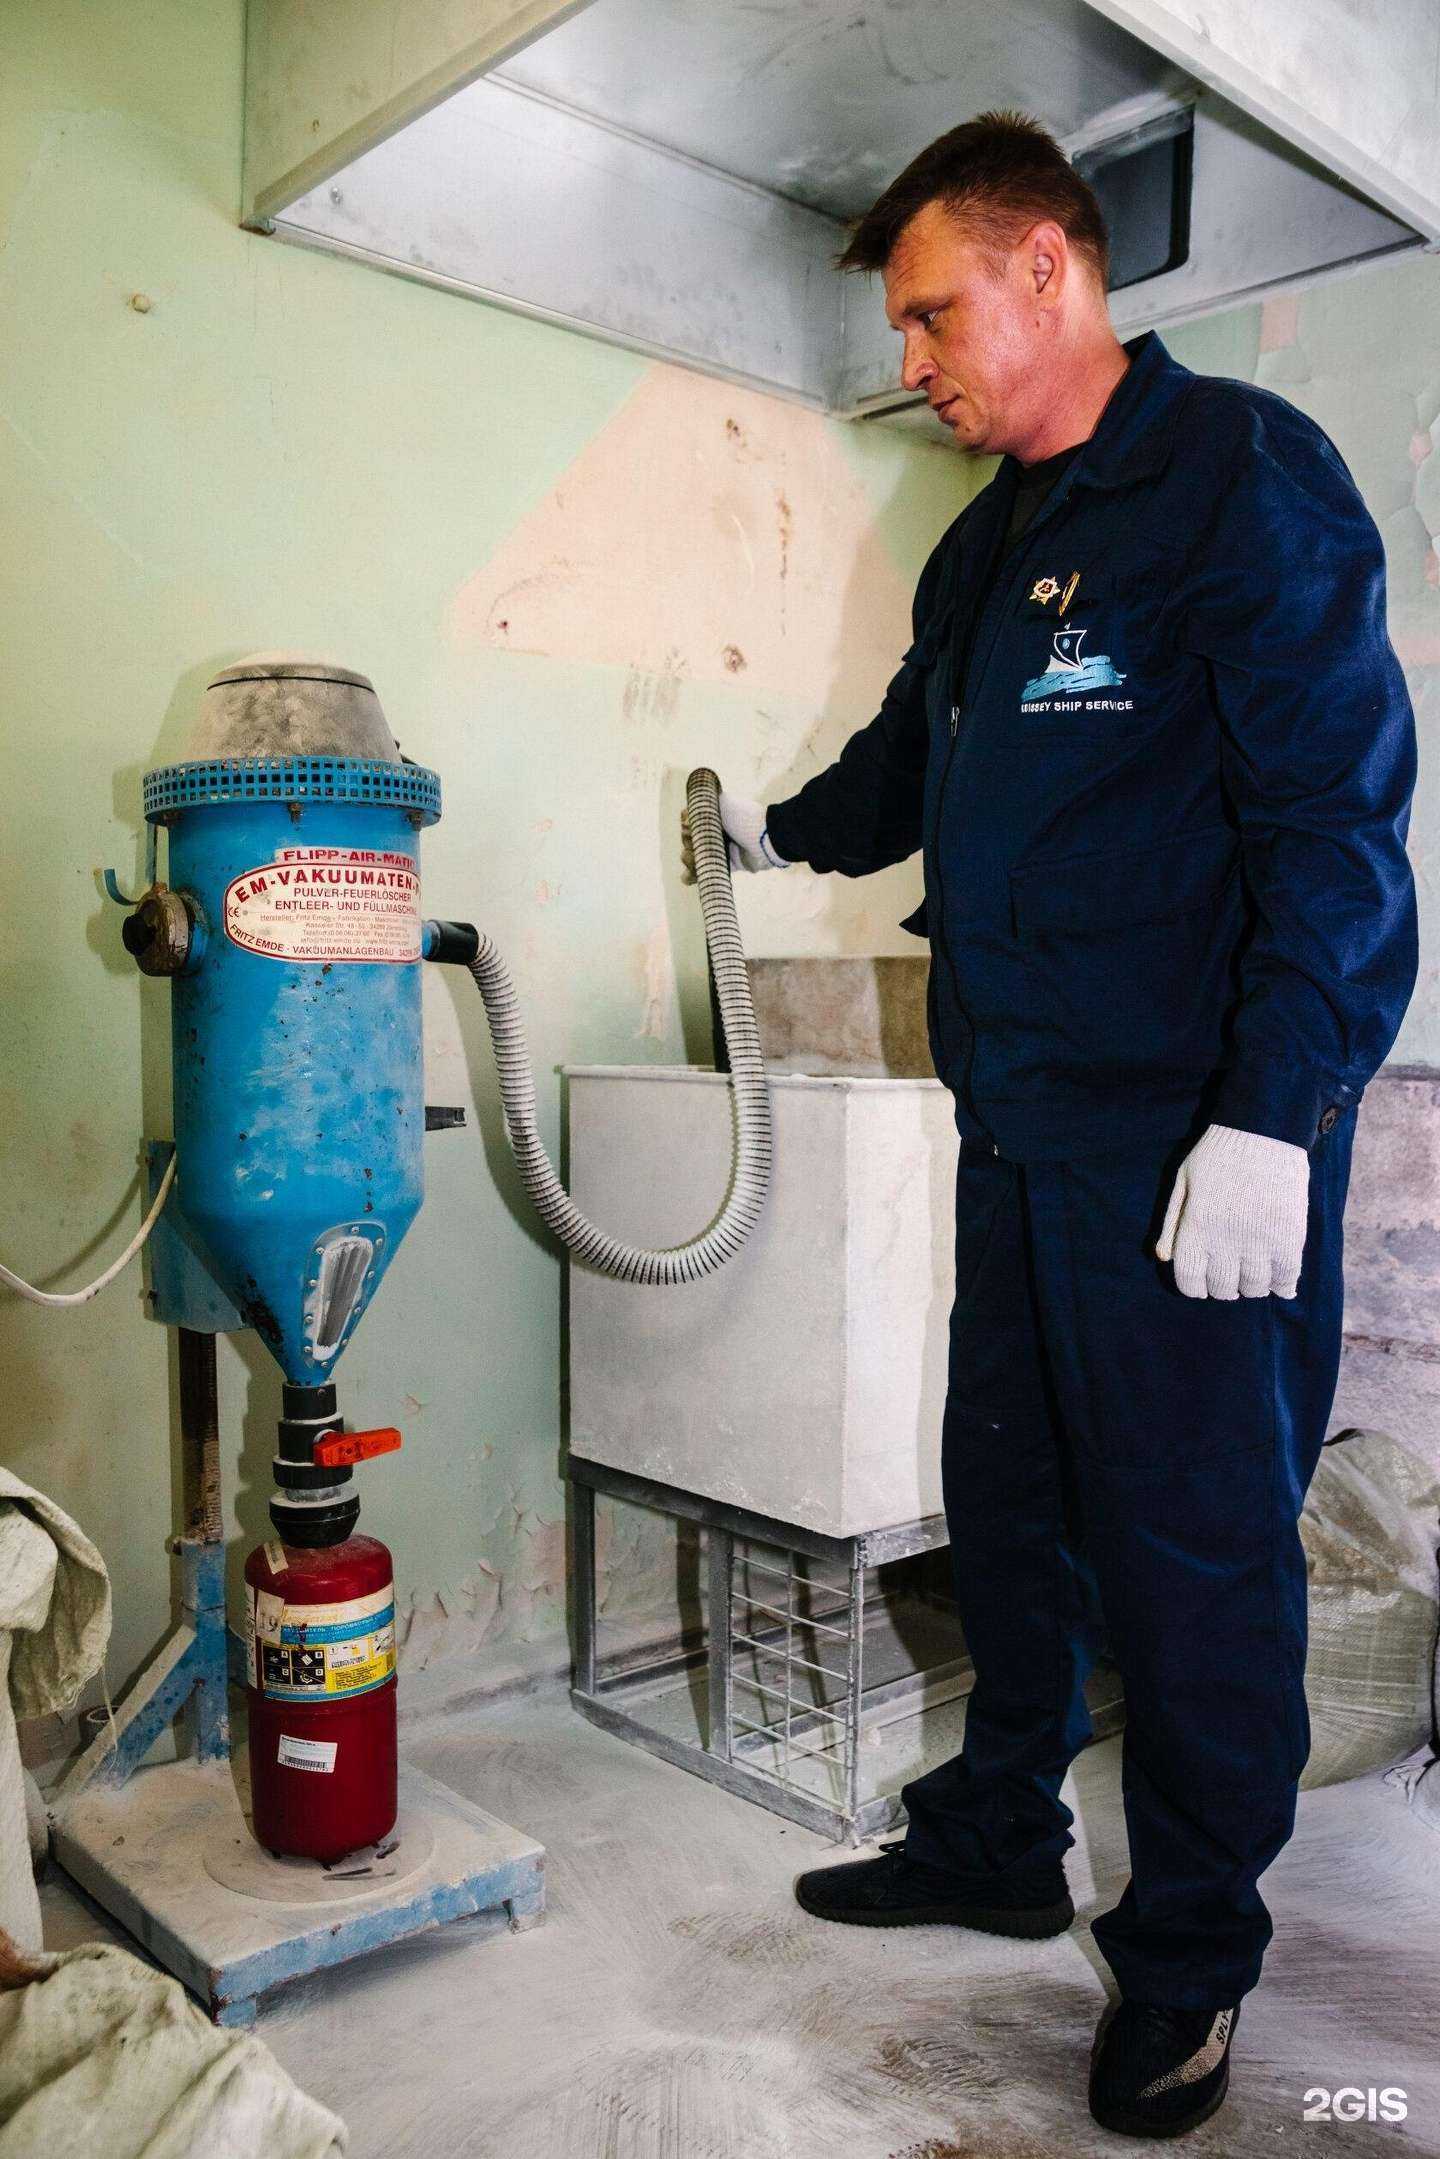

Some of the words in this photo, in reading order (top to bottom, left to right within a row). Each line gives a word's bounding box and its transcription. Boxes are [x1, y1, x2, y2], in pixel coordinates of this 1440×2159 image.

[1054, 701, 1082, 712] SHIP
[1086, 700, 1134, 711] SERVICE
[275, 900, 334, 910] ENTLEER-
[337, 901, 360, 911] UND
[230, 924, 255, 944] FRITZ
[255, 938, 285, 952] EMDE
[292, 945, 394, 956] VAKUUMANLAGENBAU
